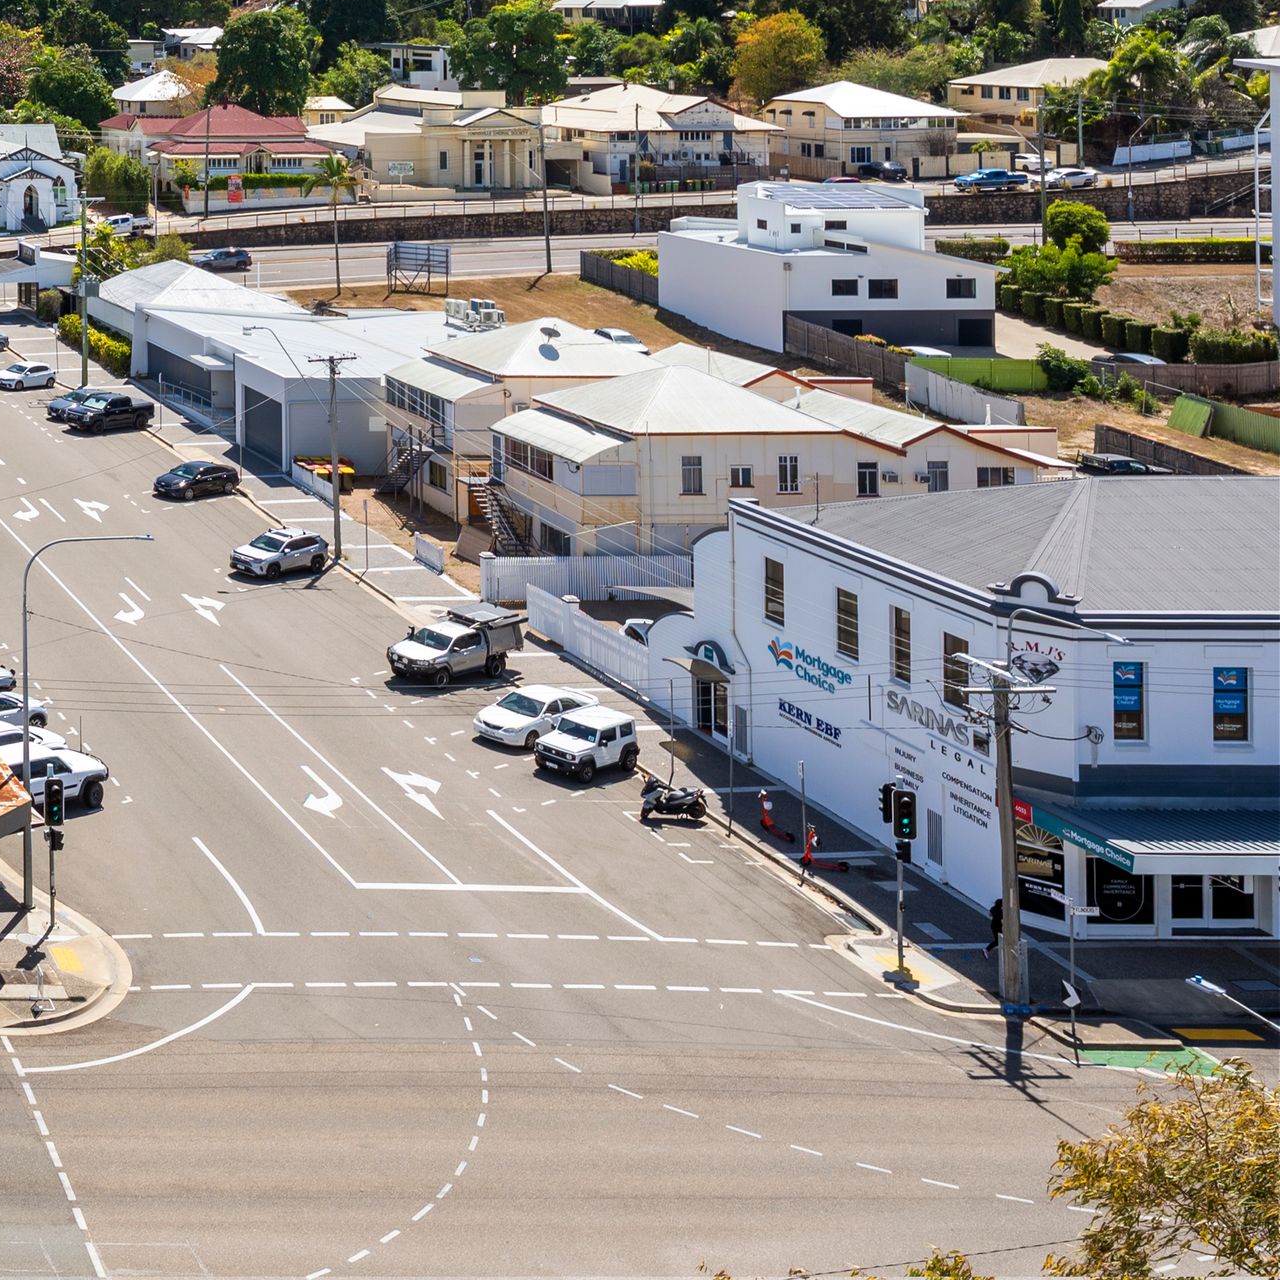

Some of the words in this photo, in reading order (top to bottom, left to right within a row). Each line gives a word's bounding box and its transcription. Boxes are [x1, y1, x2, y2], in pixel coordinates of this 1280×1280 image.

[795, 645, 852, 685] Mortgage
[795, 664, 836, 694] Choice
[778, 698, 812, 726] KERN
[816, 717, 842, 740] EBF
[887, 690, 970, 746] SARINAS
[895, 747, 917, 763] INJURY
[930, 740, 986, 775] LEGAL
[895, 762, 924, 783] BUSINESS
[902, 777, 919, 791] AMILY
[942, 771, 992, 803] COMPENSATION
[950, 791, 992, 819] INHERITANCE
[953, 804, 988, 829] LITIGATION
[1071, 830, 1104, 854] Mortgage
[1105, 848, 1131, 867] Choice
